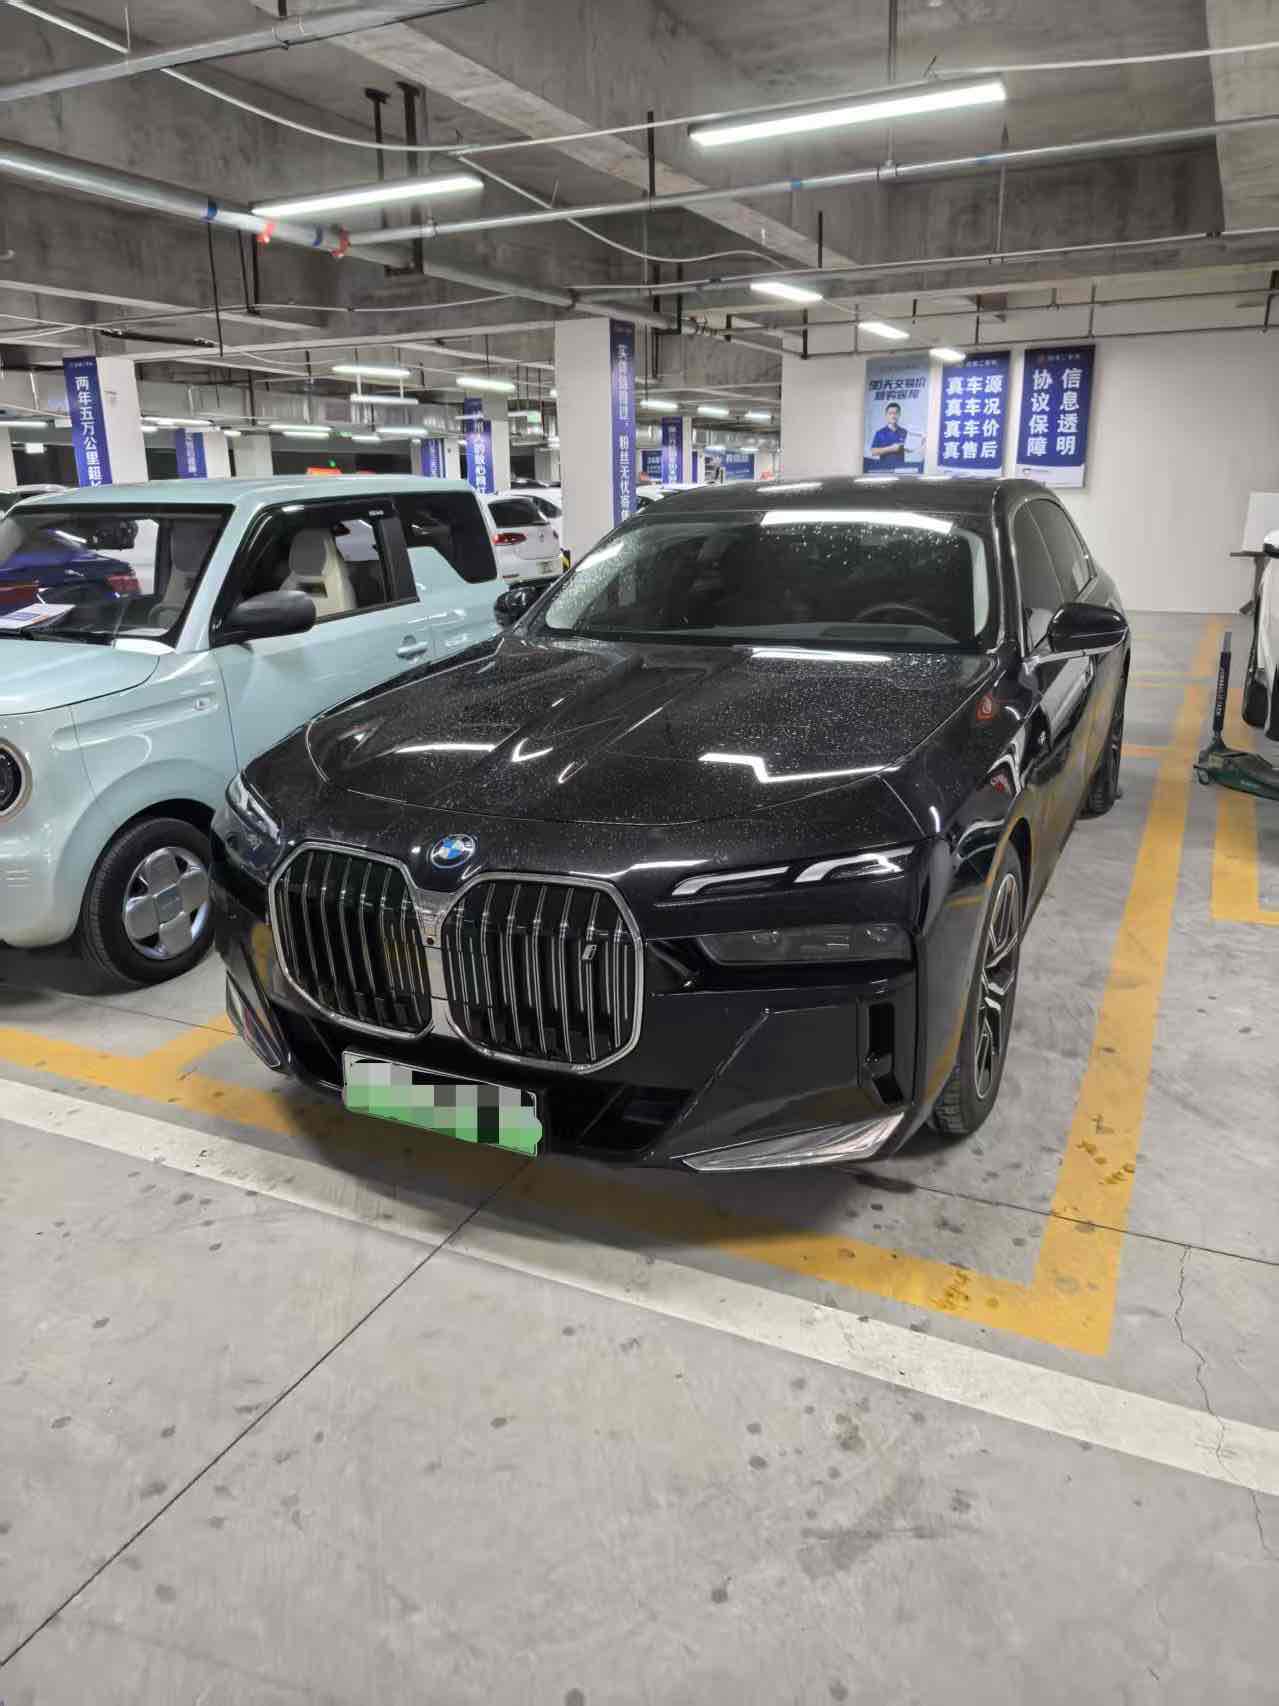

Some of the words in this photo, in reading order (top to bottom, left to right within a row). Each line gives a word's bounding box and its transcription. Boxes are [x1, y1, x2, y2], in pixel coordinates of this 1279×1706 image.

[946, 375, 1003, 394] 真车源
[945, 398, 1001, 417] 真车况
[1027, 369, 1053, 457] 协议保障
[1056, 368, 1082, 456] 信息透明
[944, 419, 1000, 438] 真车价
[943, 441, 998, 459] 真售后
